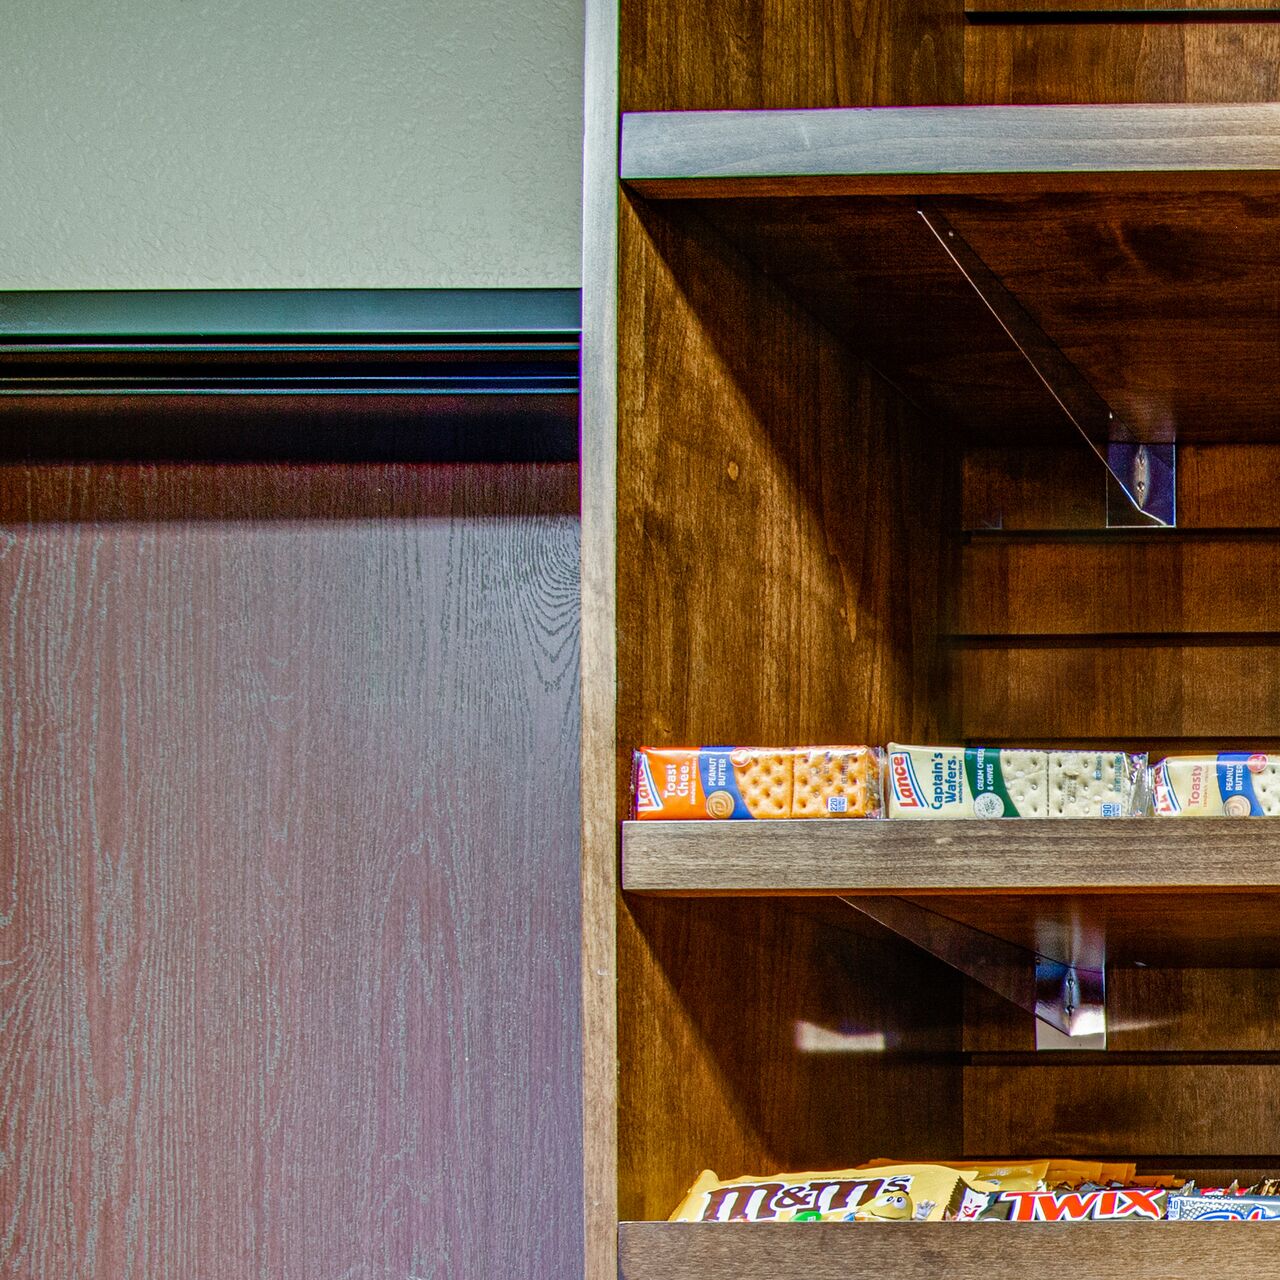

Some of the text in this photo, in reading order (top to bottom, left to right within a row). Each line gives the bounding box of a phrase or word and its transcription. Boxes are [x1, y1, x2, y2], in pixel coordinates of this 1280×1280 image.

[664, 763, 677, 799] Toast
[676, 763, 690, 797] Chee
[708, 757, 717, 787] PEANUT
[718, 758, 727, 787] BUTTER
[895, 754, 920, 810] Lance
[930, 751, 944, 811] Captain's
[944, 757, 958, 805] Wafers
[986, 763, 994, 792] & CHIVES
[1187, 764, 1203, 807] Toasty
[1225, 763, 1235, 792] PEANUT
[1234, 764, 1244, 791] BUTTER
[829, 797, 838, 812] 220
[1003, 1189, 1166, 1222] TWIX
